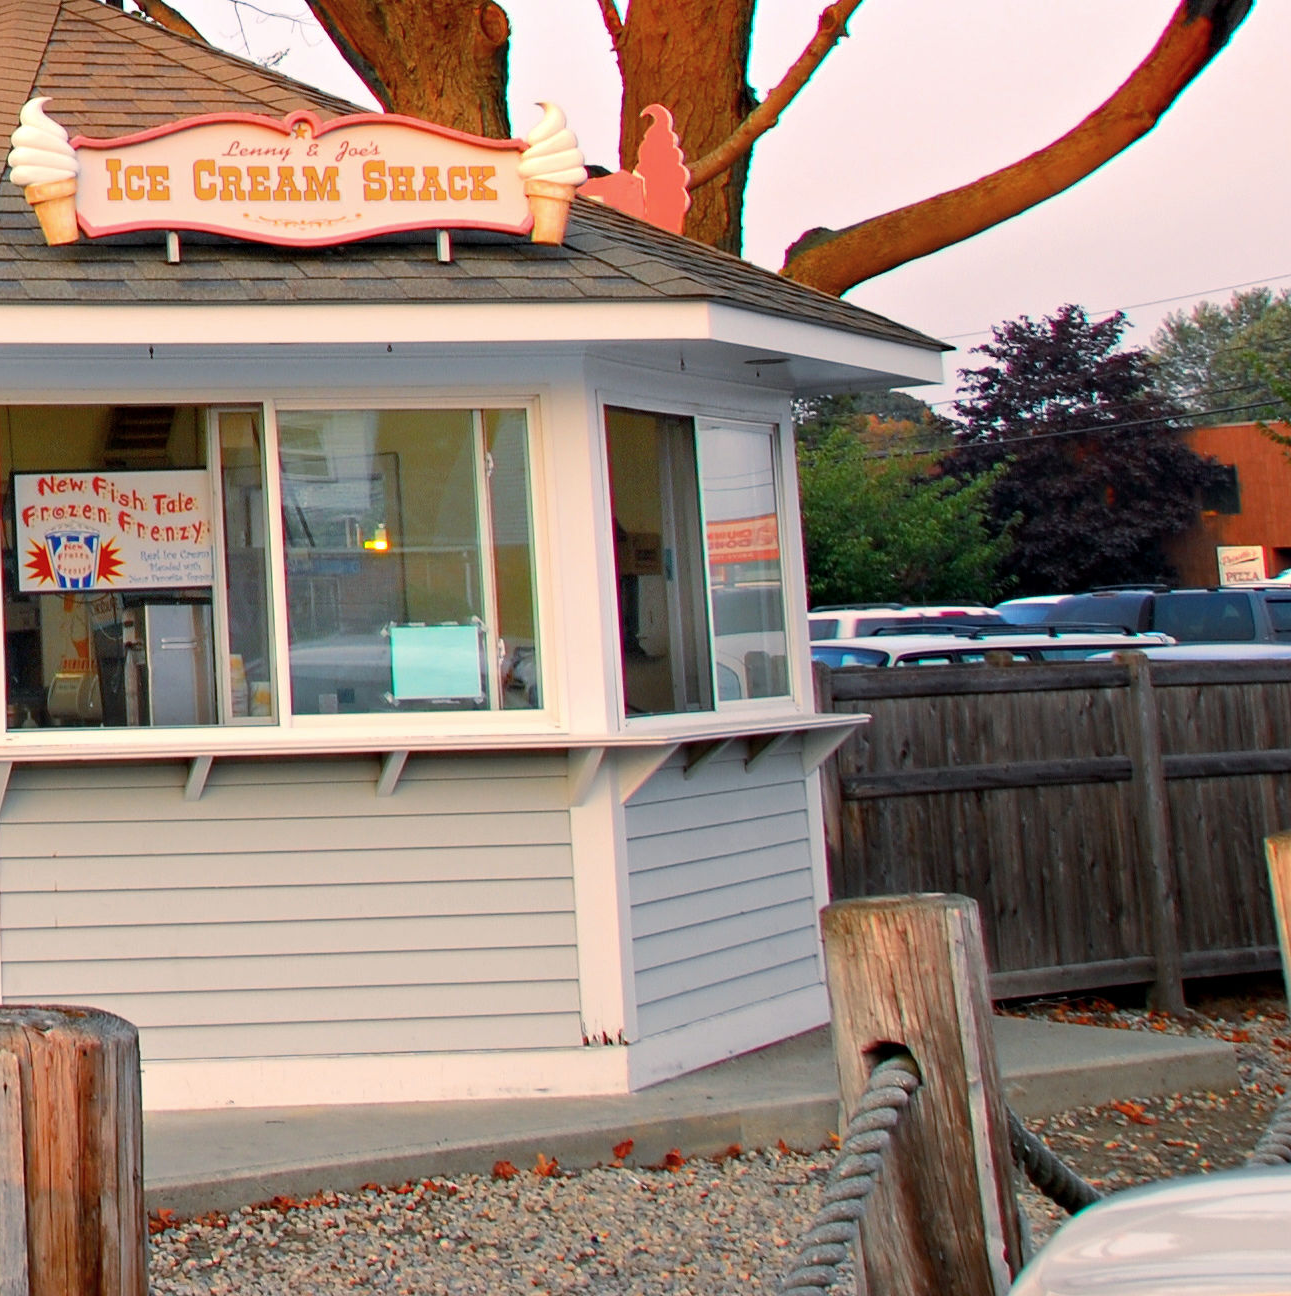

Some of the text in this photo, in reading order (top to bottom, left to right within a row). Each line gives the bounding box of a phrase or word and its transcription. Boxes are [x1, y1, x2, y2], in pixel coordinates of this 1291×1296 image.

[222, 141, 381, 161] Lenny & Joe's
[38, 476, 193, 515] New Fish Tale
[22, 504, 107, 527] Frozen
[1226, 572, 1260, 581] PIZZA
